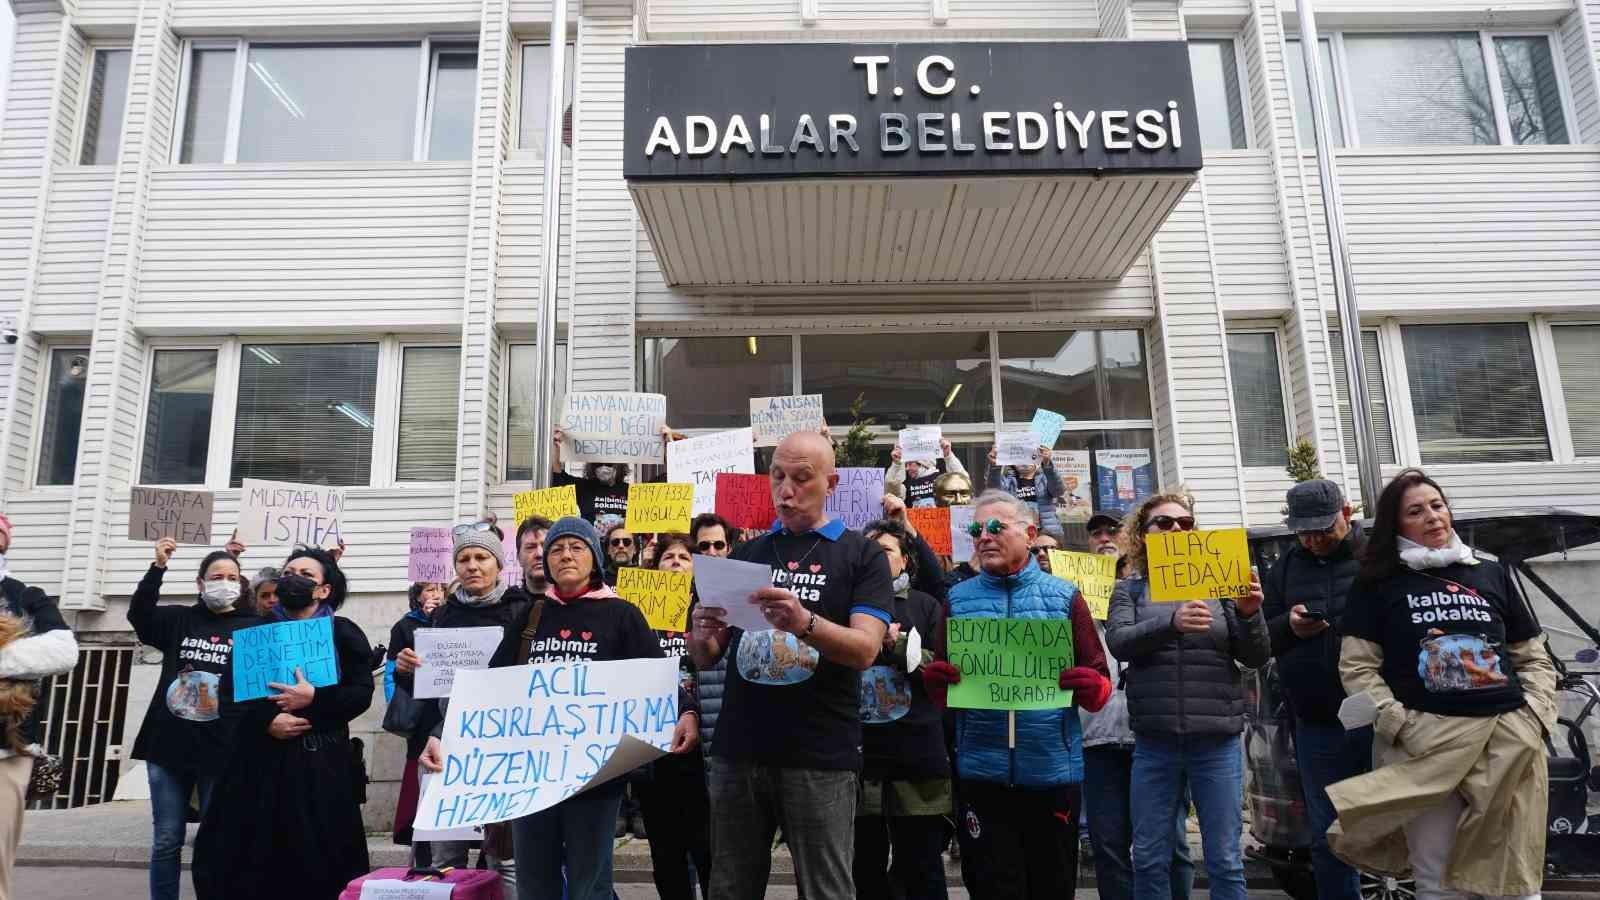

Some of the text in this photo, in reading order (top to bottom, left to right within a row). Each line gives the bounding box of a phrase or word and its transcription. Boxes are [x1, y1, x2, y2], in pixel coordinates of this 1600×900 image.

[645, 101, 1182, 157] ADALAR BELEDİYESİ
[131, 488, 204, 509] MUSTAFA
[250, 487, 344, 513] MUSTAFA ÜN
[157, 507, 182, 521] ÜN
[1411, 606, 1492, 624] sokakta
[949, 618, 1072, 648] BÜYÜKADA
[526, 663, 607, 699] ACİL
[989, 681, 1057, 703] BURADA
[458, 693, 678, 740] KISIRLAŞTIRMA
[443, 744, 571, 786] DÜZENLİ
[433, 786, 541, 828] HİZMET
